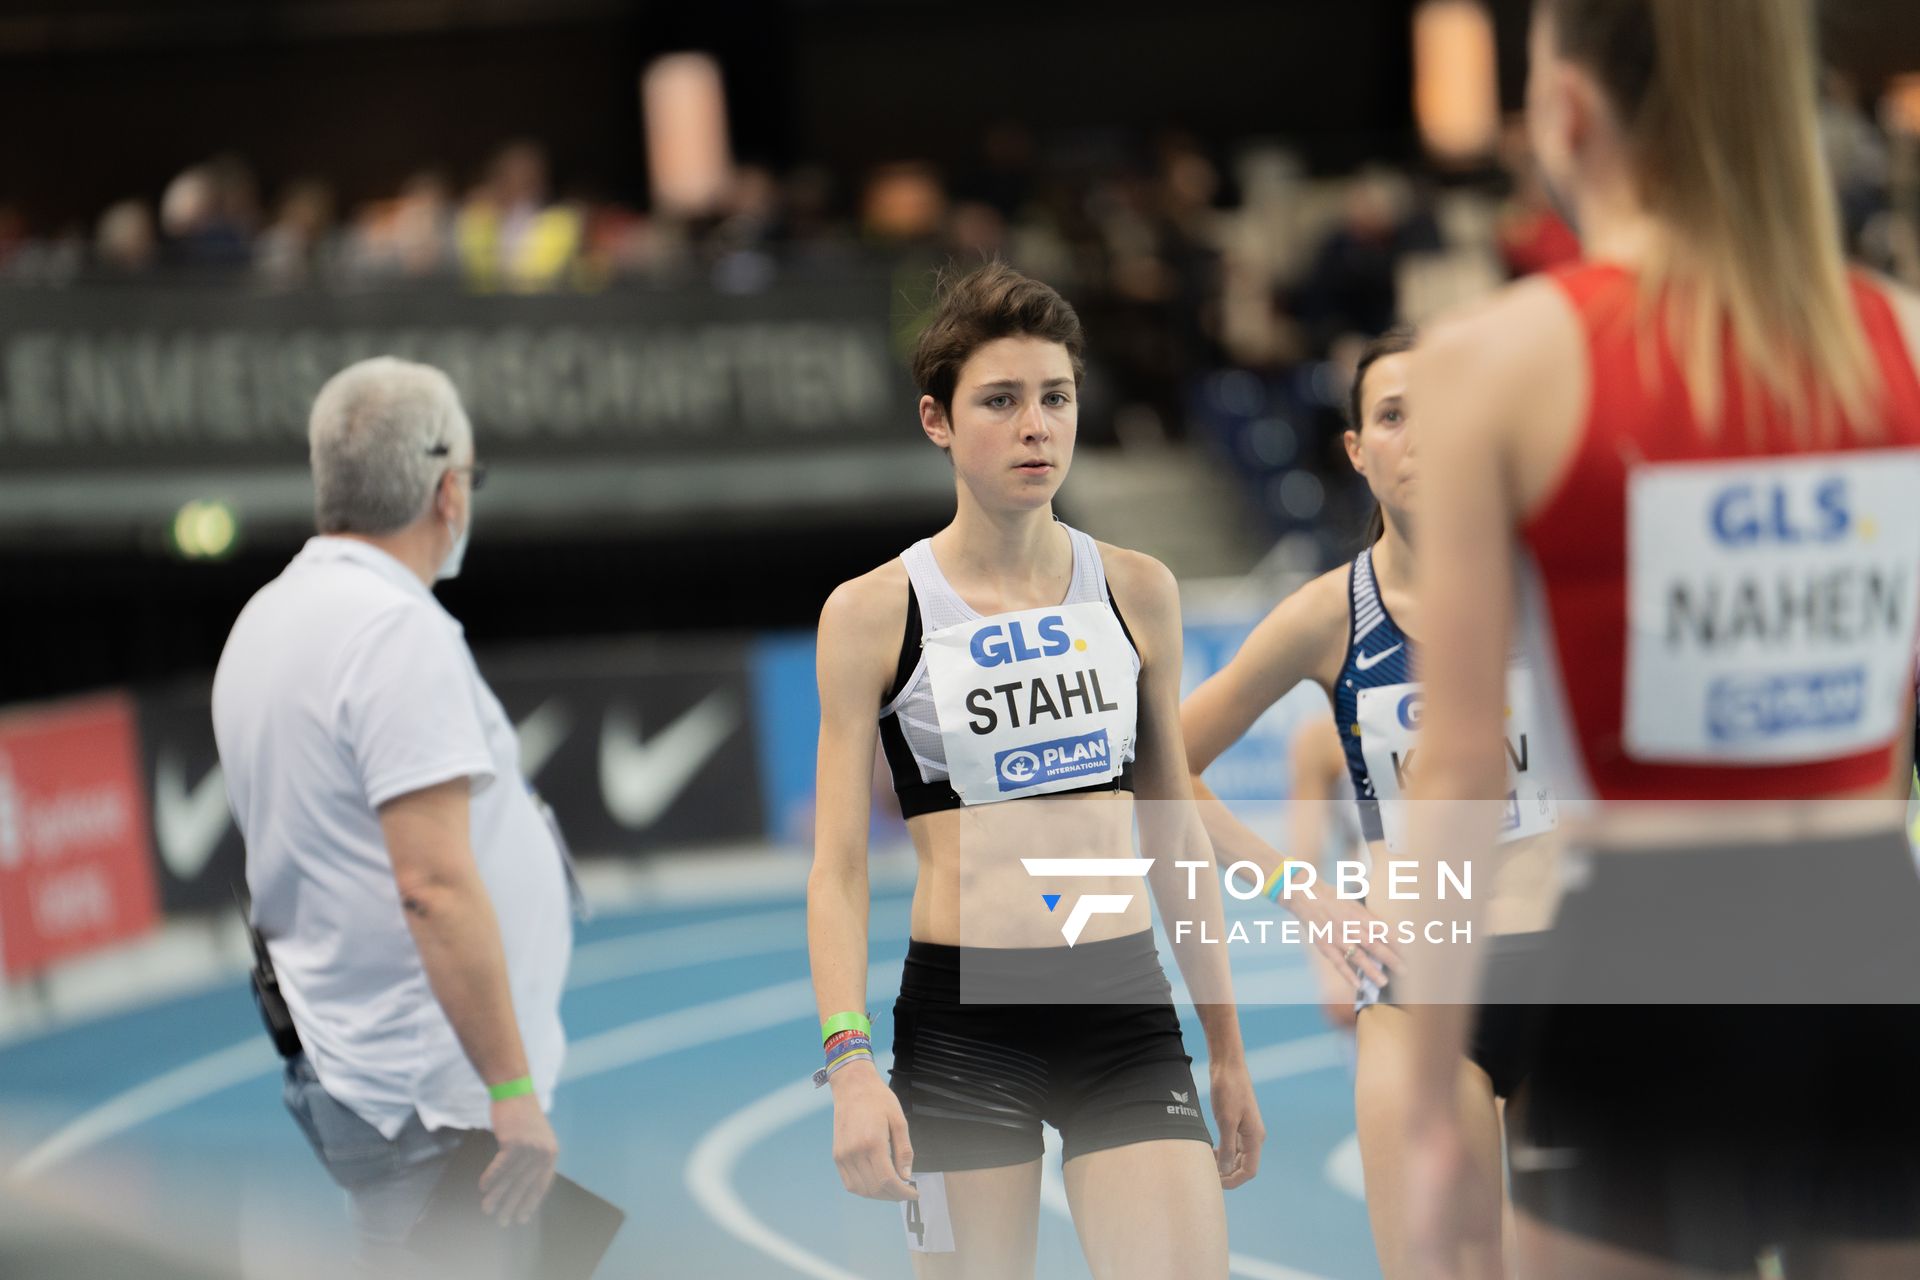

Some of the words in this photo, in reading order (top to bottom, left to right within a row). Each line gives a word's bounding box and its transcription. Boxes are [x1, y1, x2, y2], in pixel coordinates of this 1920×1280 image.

[1664, 567, 1905, 653] NAHEN
[970, 615, 1087, 668] GLS.
[965, 668, 1118, 736] STAHL
[1043, 738, 1107, 767] PLAN
[1047, 760, 1108, 776] INTERNATIONAL
[1166, 1104, 1199, 1118] erima
